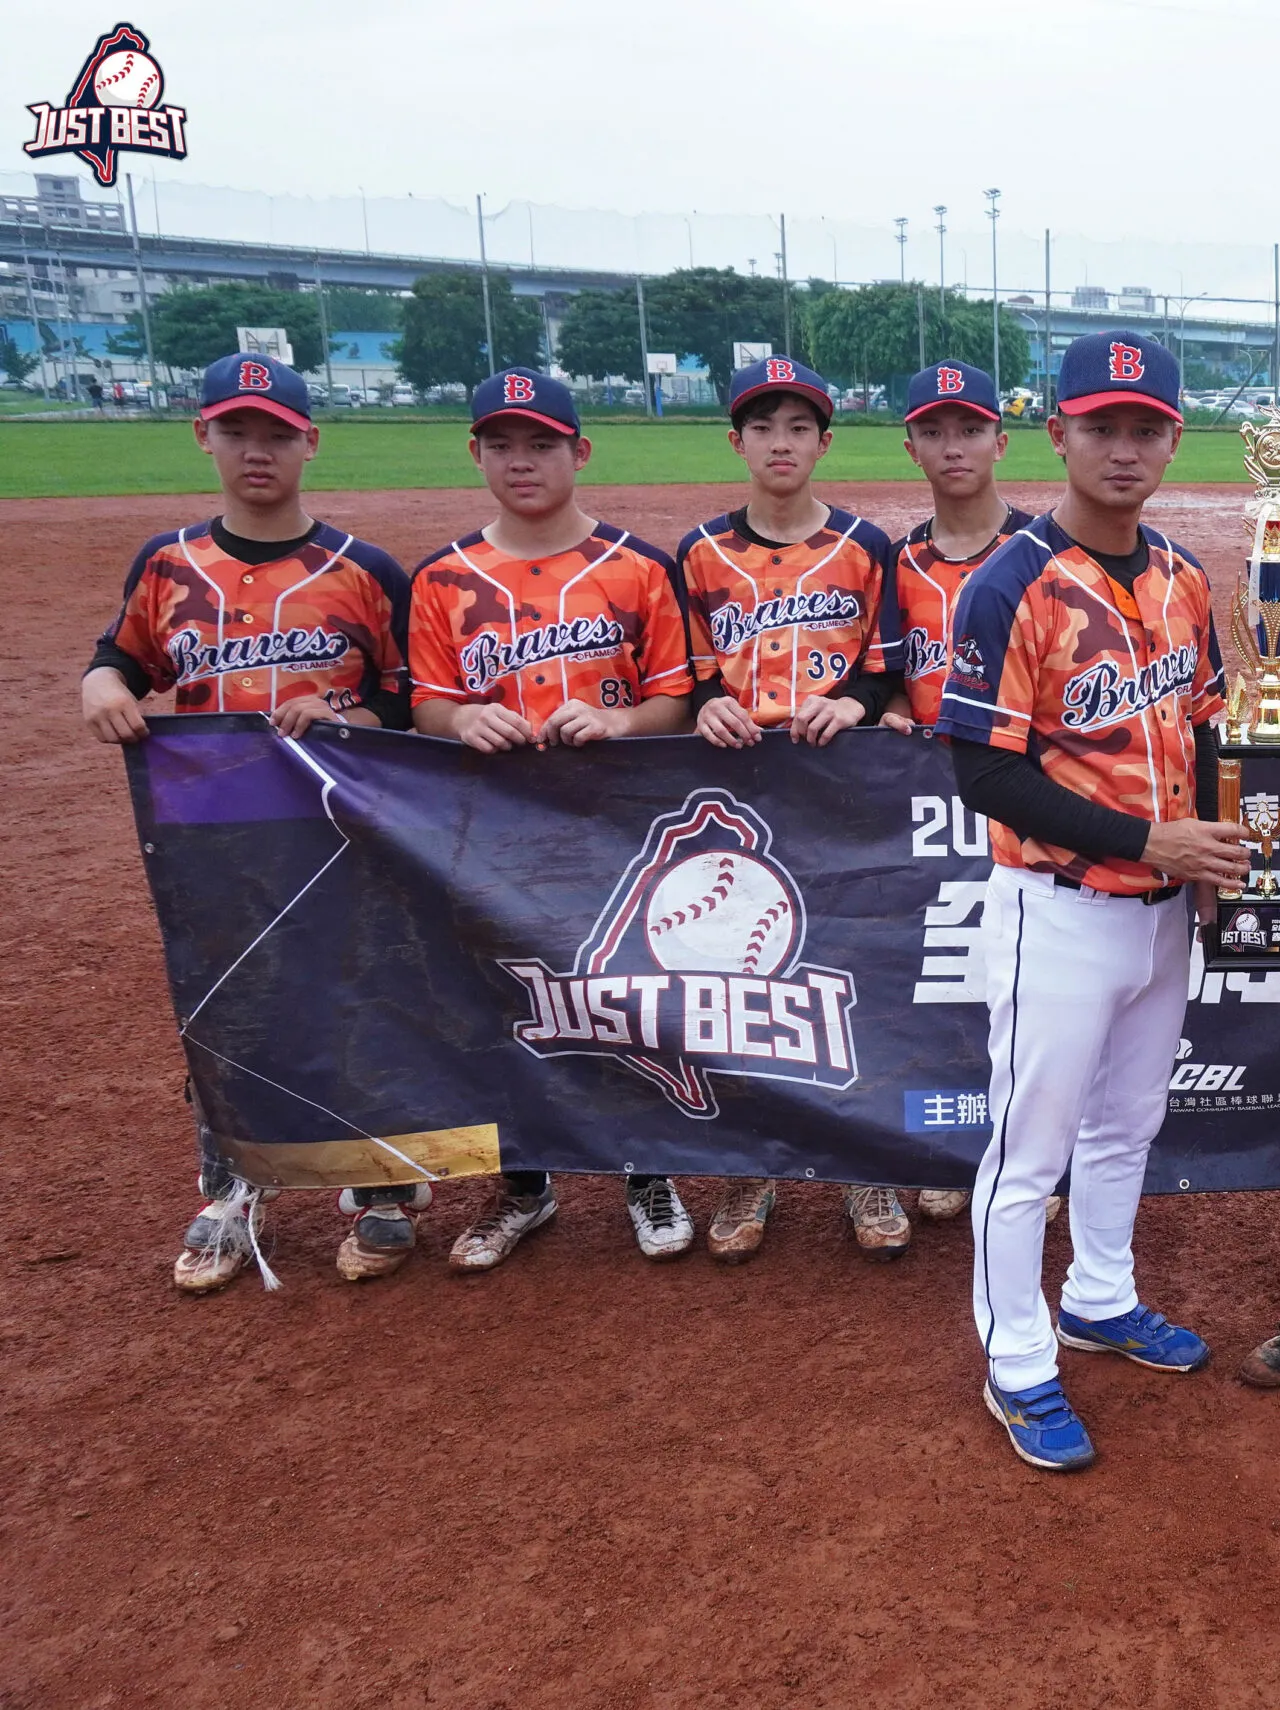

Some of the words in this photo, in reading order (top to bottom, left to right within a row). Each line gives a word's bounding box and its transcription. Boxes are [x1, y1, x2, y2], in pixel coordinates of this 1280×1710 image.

[239, 361, 273, 390] B
[766, 358, 796, 382] B
[1108, 341, 1144, 381] B
[504, 374, 536, 403] B
[937, 367, 964, 395] B
[710, 590, 859, 655] Braves
[168, 627, 348, 686] Braves
[460, 613, 624, 693] Braves
[807, 650, 847, 680] 39
[510, 966, 670, 1049] JUST
[678, 973, 849, 1070] BEST
